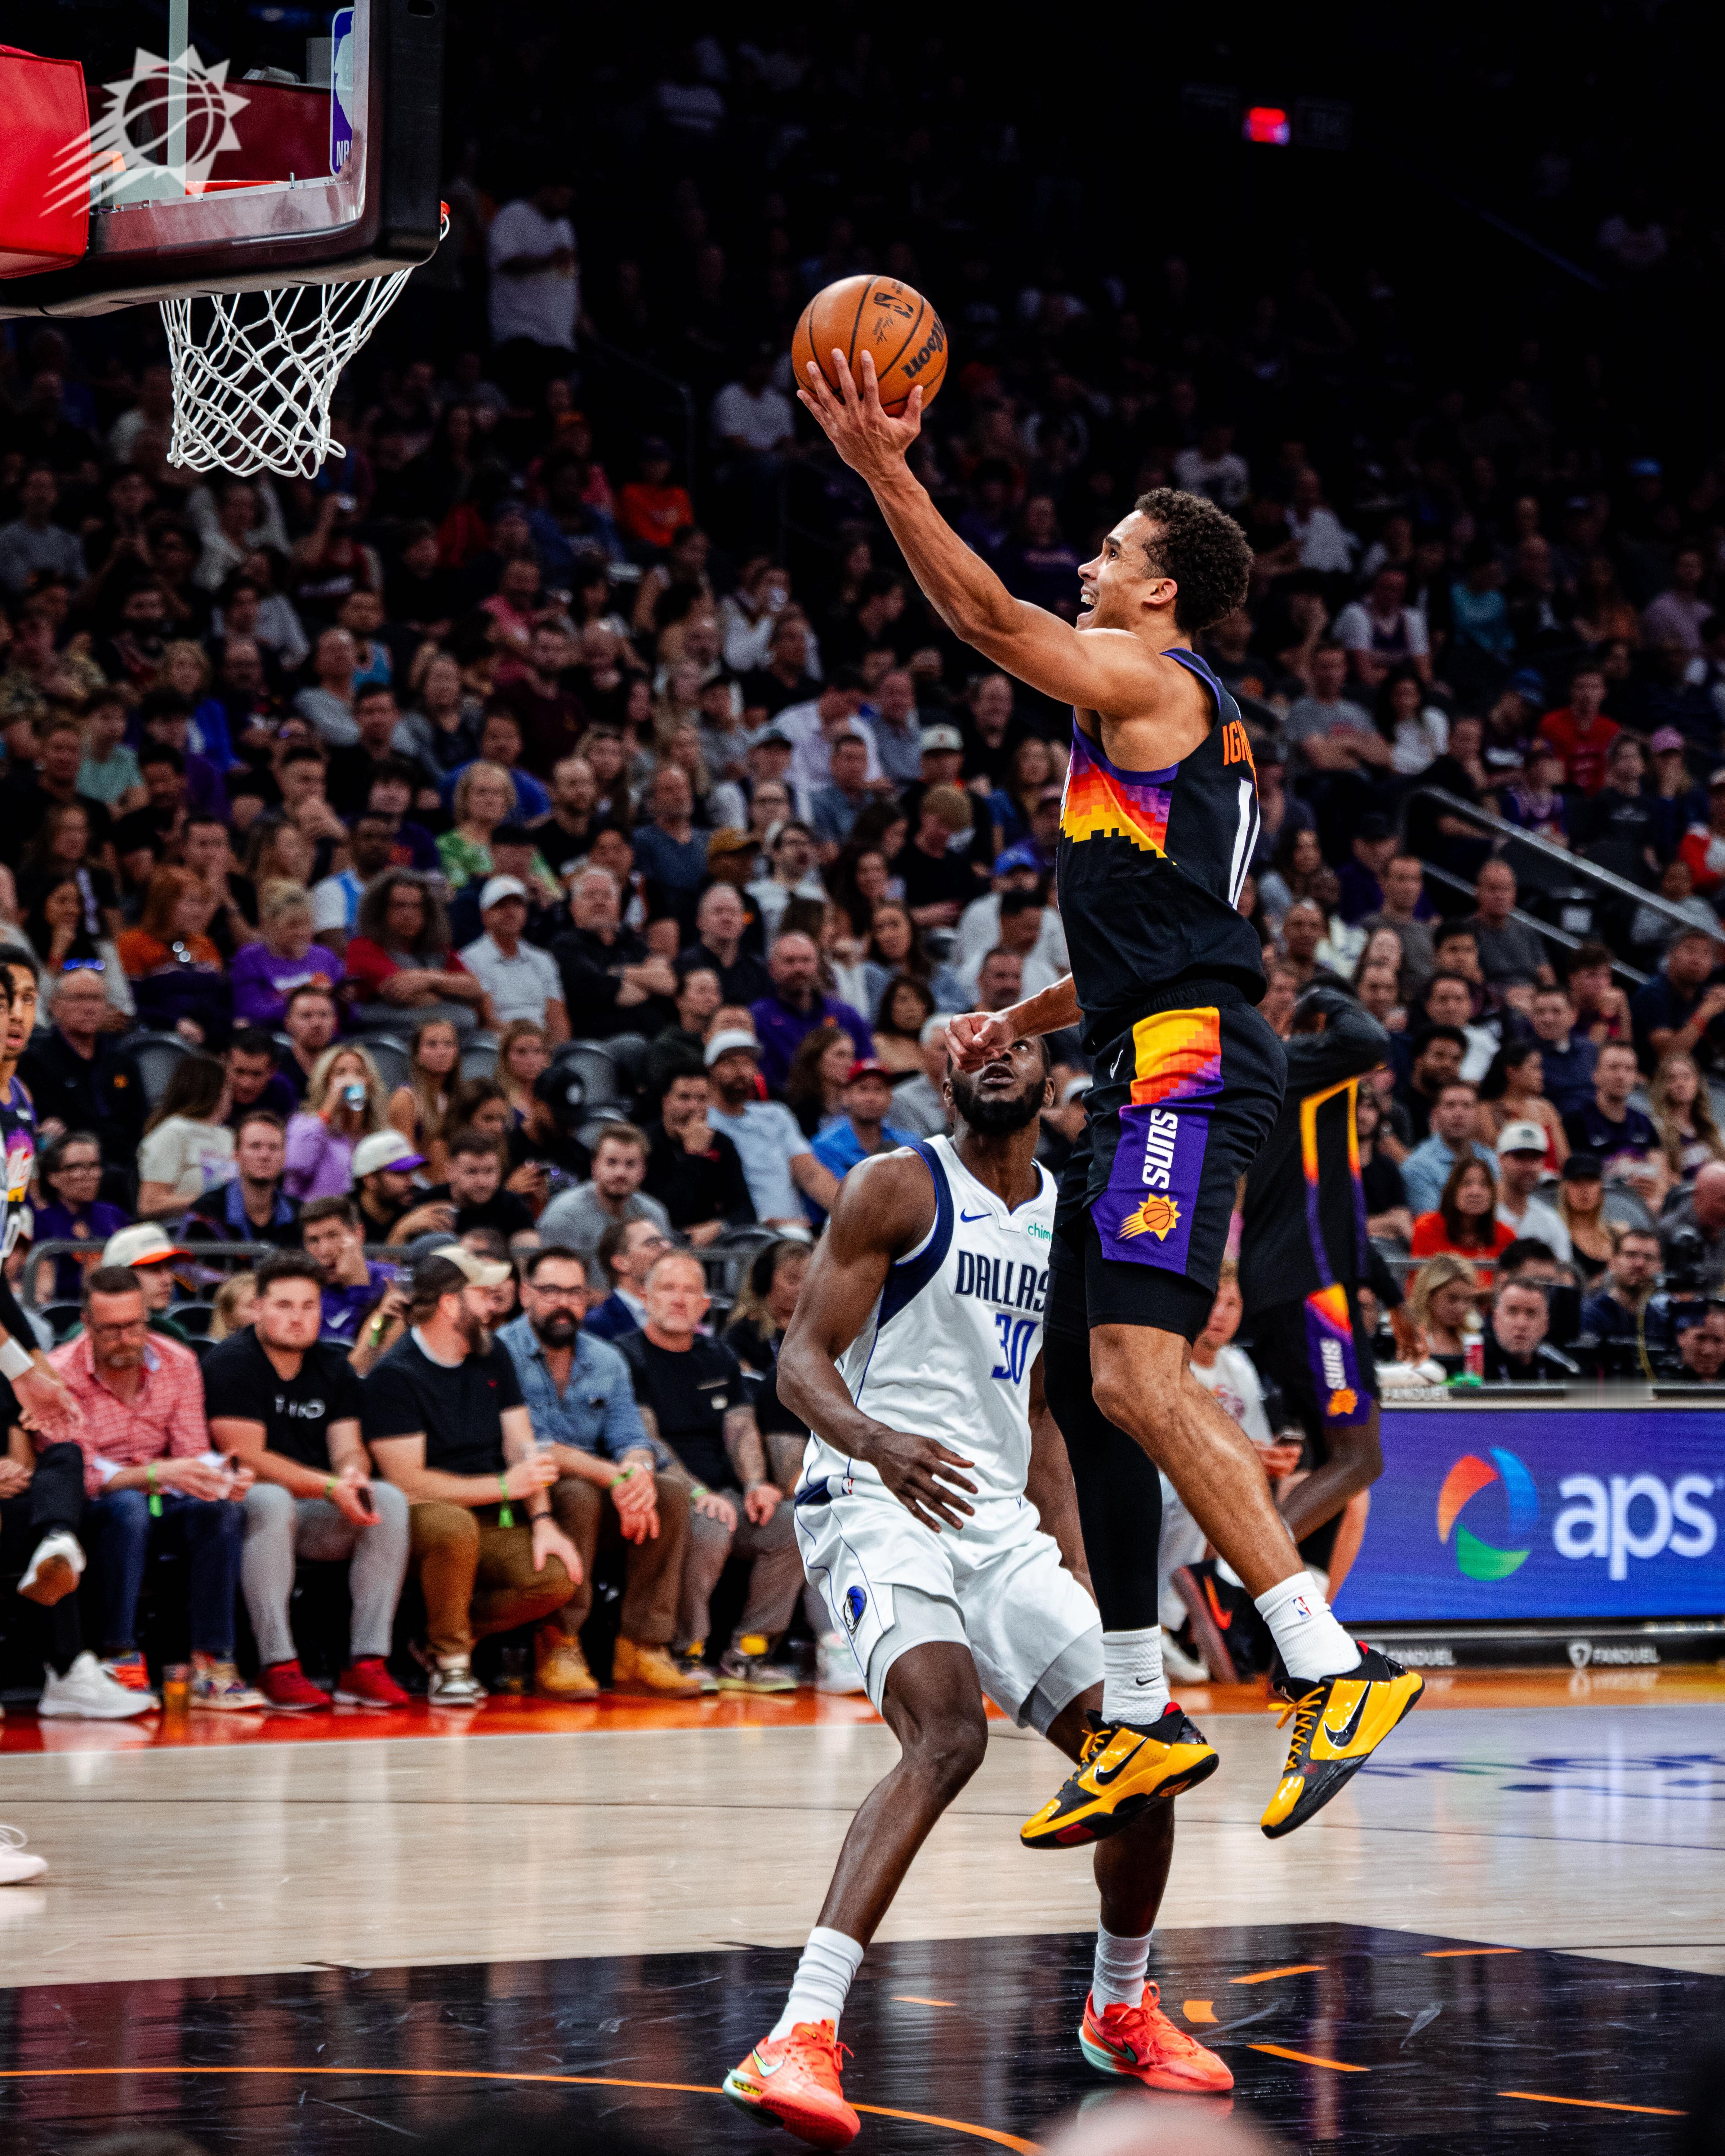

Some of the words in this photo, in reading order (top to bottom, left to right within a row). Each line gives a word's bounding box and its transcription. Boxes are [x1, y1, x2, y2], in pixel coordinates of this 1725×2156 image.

[1142, 1108, 1178, 1189] SUNS
[954, 1248, 1049, 1313] DALLAS
[991, 1312, 1040, 1387] 30
[1320, 1338, 1347, 1390] SUNS
[1553, 1474, 1717, 1581] aps
